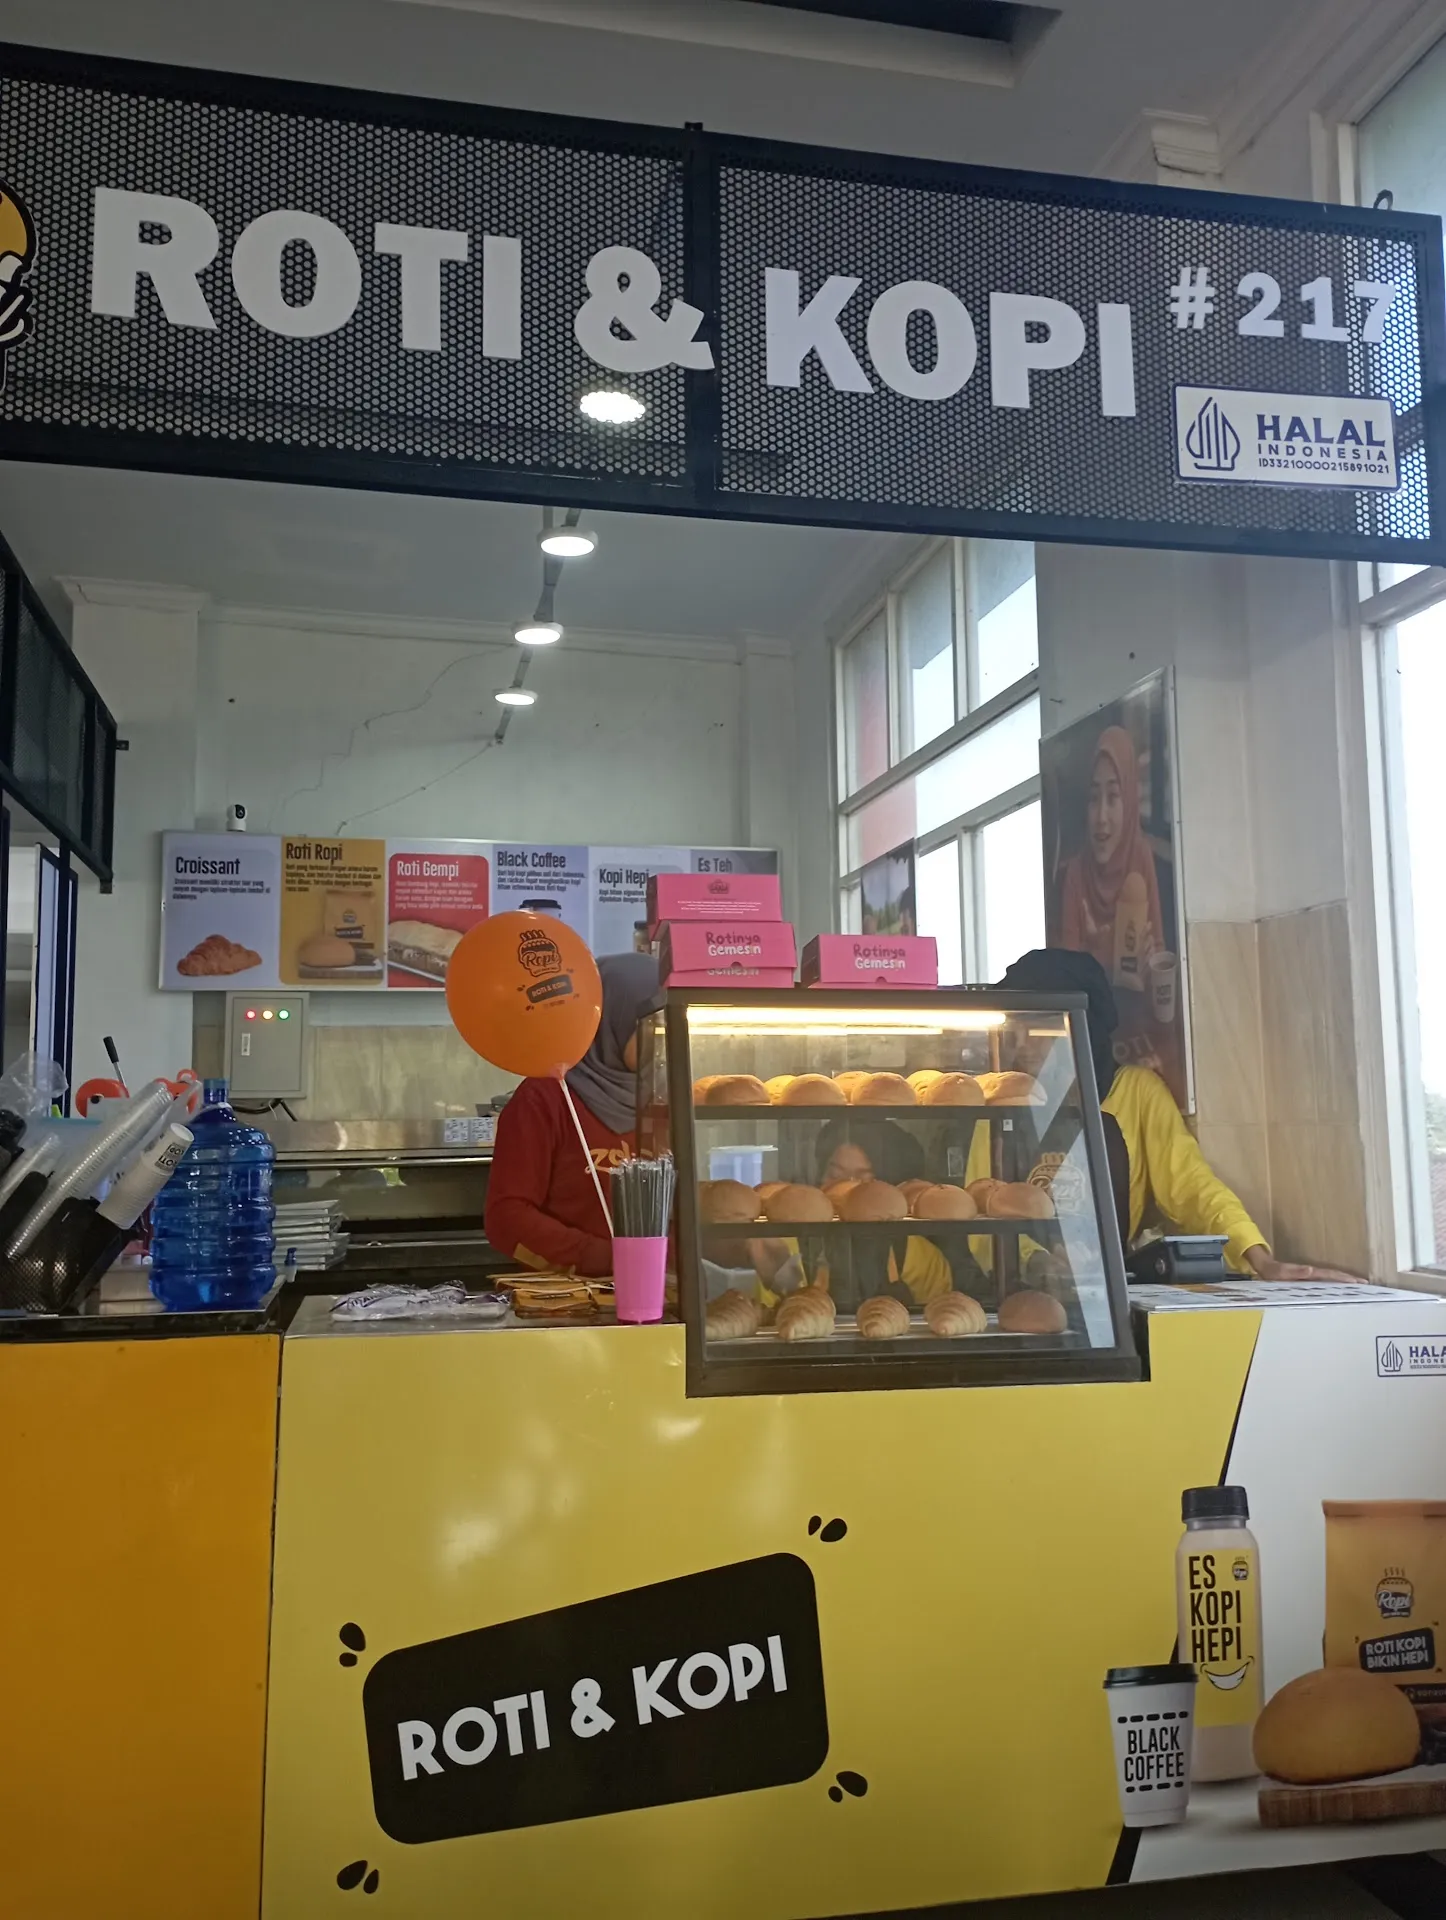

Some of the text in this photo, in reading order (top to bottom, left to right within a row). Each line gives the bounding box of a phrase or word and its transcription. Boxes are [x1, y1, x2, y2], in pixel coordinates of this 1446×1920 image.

[91, 186, 1137, 418] ROTI & KOPI
[1256, 414, 1386, 447] HALAL
[1258, 443, 1387, 461] INDONESIA
[1259, 458, 1389, 474] ID33210000215891021
[286, 842, 343, 865] Roti Ropi
[497, 850, 566, 869] Black Coffee
[175, 856, 241, 875] Croissant
[397, 860, 420, 877] Roti
[423, 860, 459, 881] Gempi
[697, 857, 733, 873] Es Teh
[599, 868, 623, 888] Kopi
[705, 931, 761, 945] Rotinya
[707, 945, 761, 957] Gemesin
[853, 942, 906, 958] Rotinya
[855, 957, 905, 969] Gemesin
[1189, 1554, 1216, 1590] ES
[1190, 1590, 1241, 1626] KOPI
[1376, 1590, 1411, 1610] Ropi
[1192, 1626, 1242, 1663] HEPI
[1365, 1636, 1427, 1656] ROTI KOPI
[1366, 1649, 1430, 1669] BIKIN HEPI
[397, 1634, 788, 1781] ROTI & KOPI
[1127, 1726, 1180, 1755] BLACK
[1124, 1752, 1185, 1782] COFFEE
